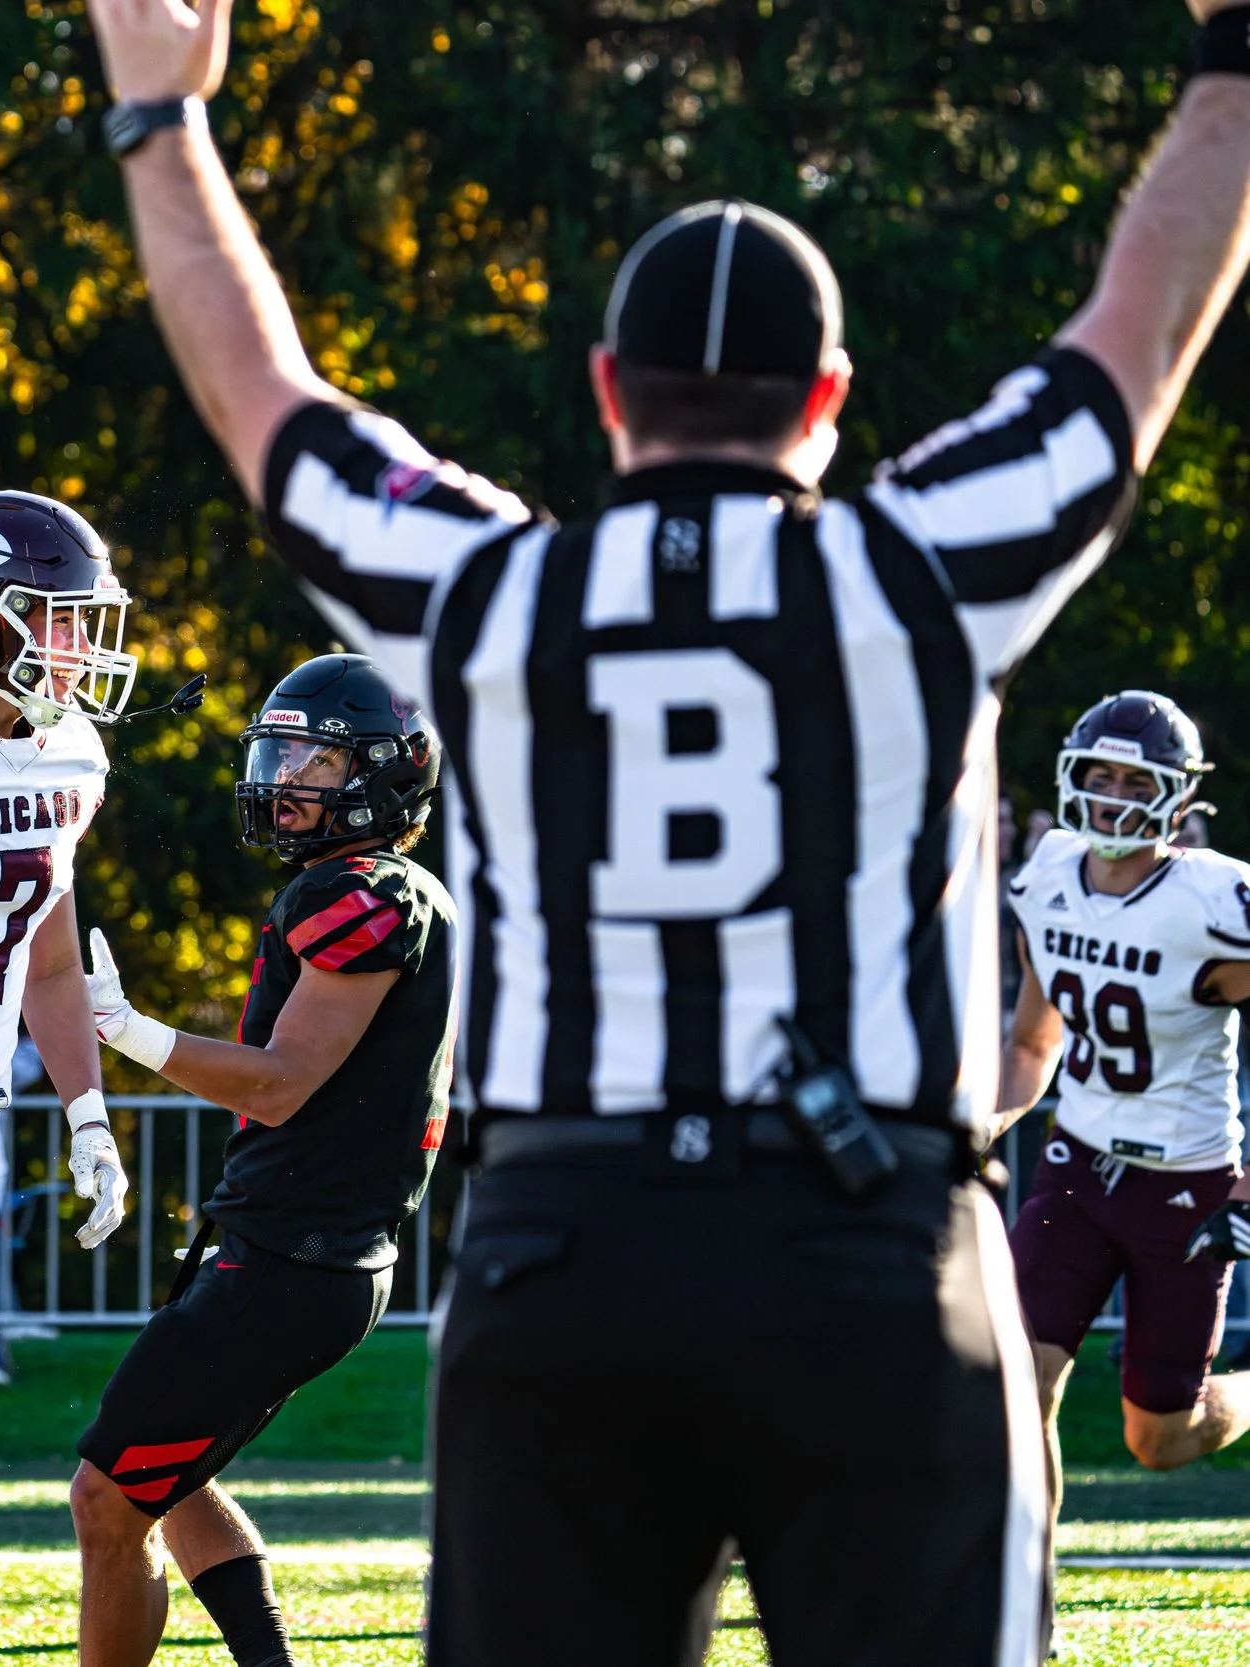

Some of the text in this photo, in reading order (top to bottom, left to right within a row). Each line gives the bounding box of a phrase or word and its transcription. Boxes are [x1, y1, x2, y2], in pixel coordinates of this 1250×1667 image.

[587, 646, 787, 921] B
[1043, 928, 1162, 976] CHICAGO
[1050, 969, 1155, 1094] 89
